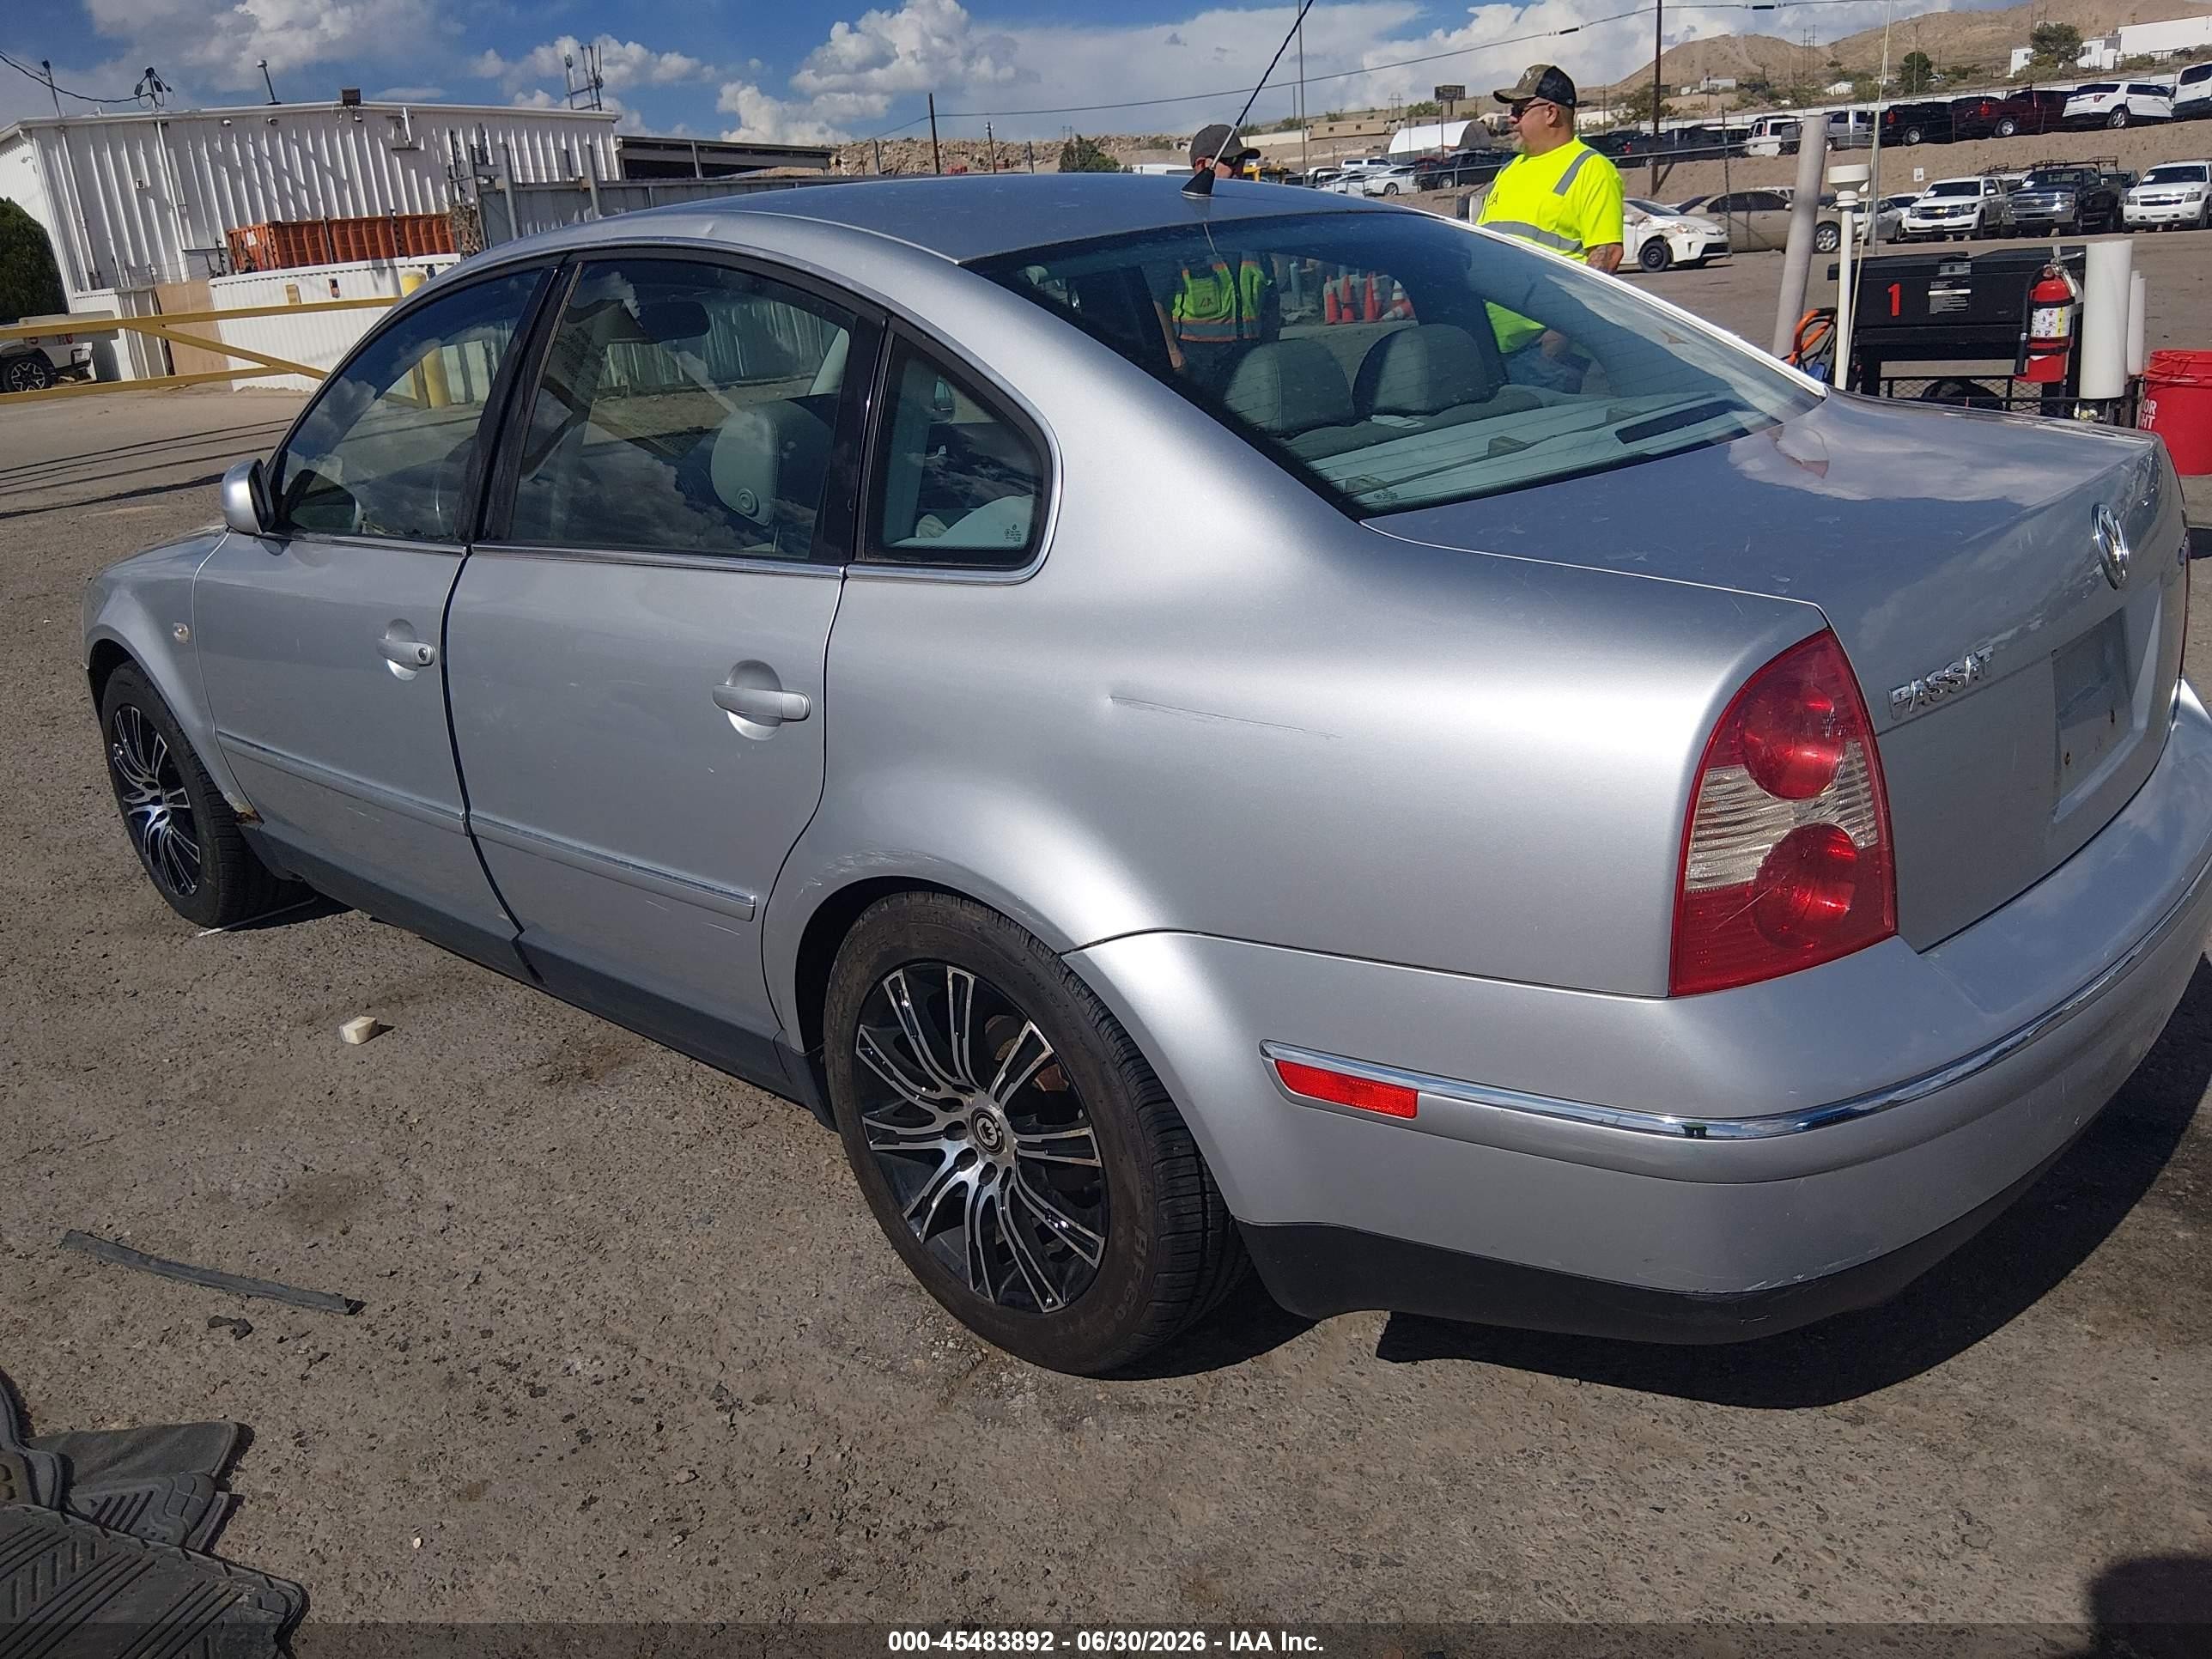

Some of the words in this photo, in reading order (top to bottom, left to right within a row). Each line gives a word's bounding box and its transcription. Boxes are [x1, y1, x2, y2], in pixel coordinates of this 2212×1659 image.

[1887, 283, 1902, 317] 1
[2142, 398, 2158, 416] OR
[2139, 413, 2156, 430] HT
[1887, 644, 1995, 720] PASSAT
